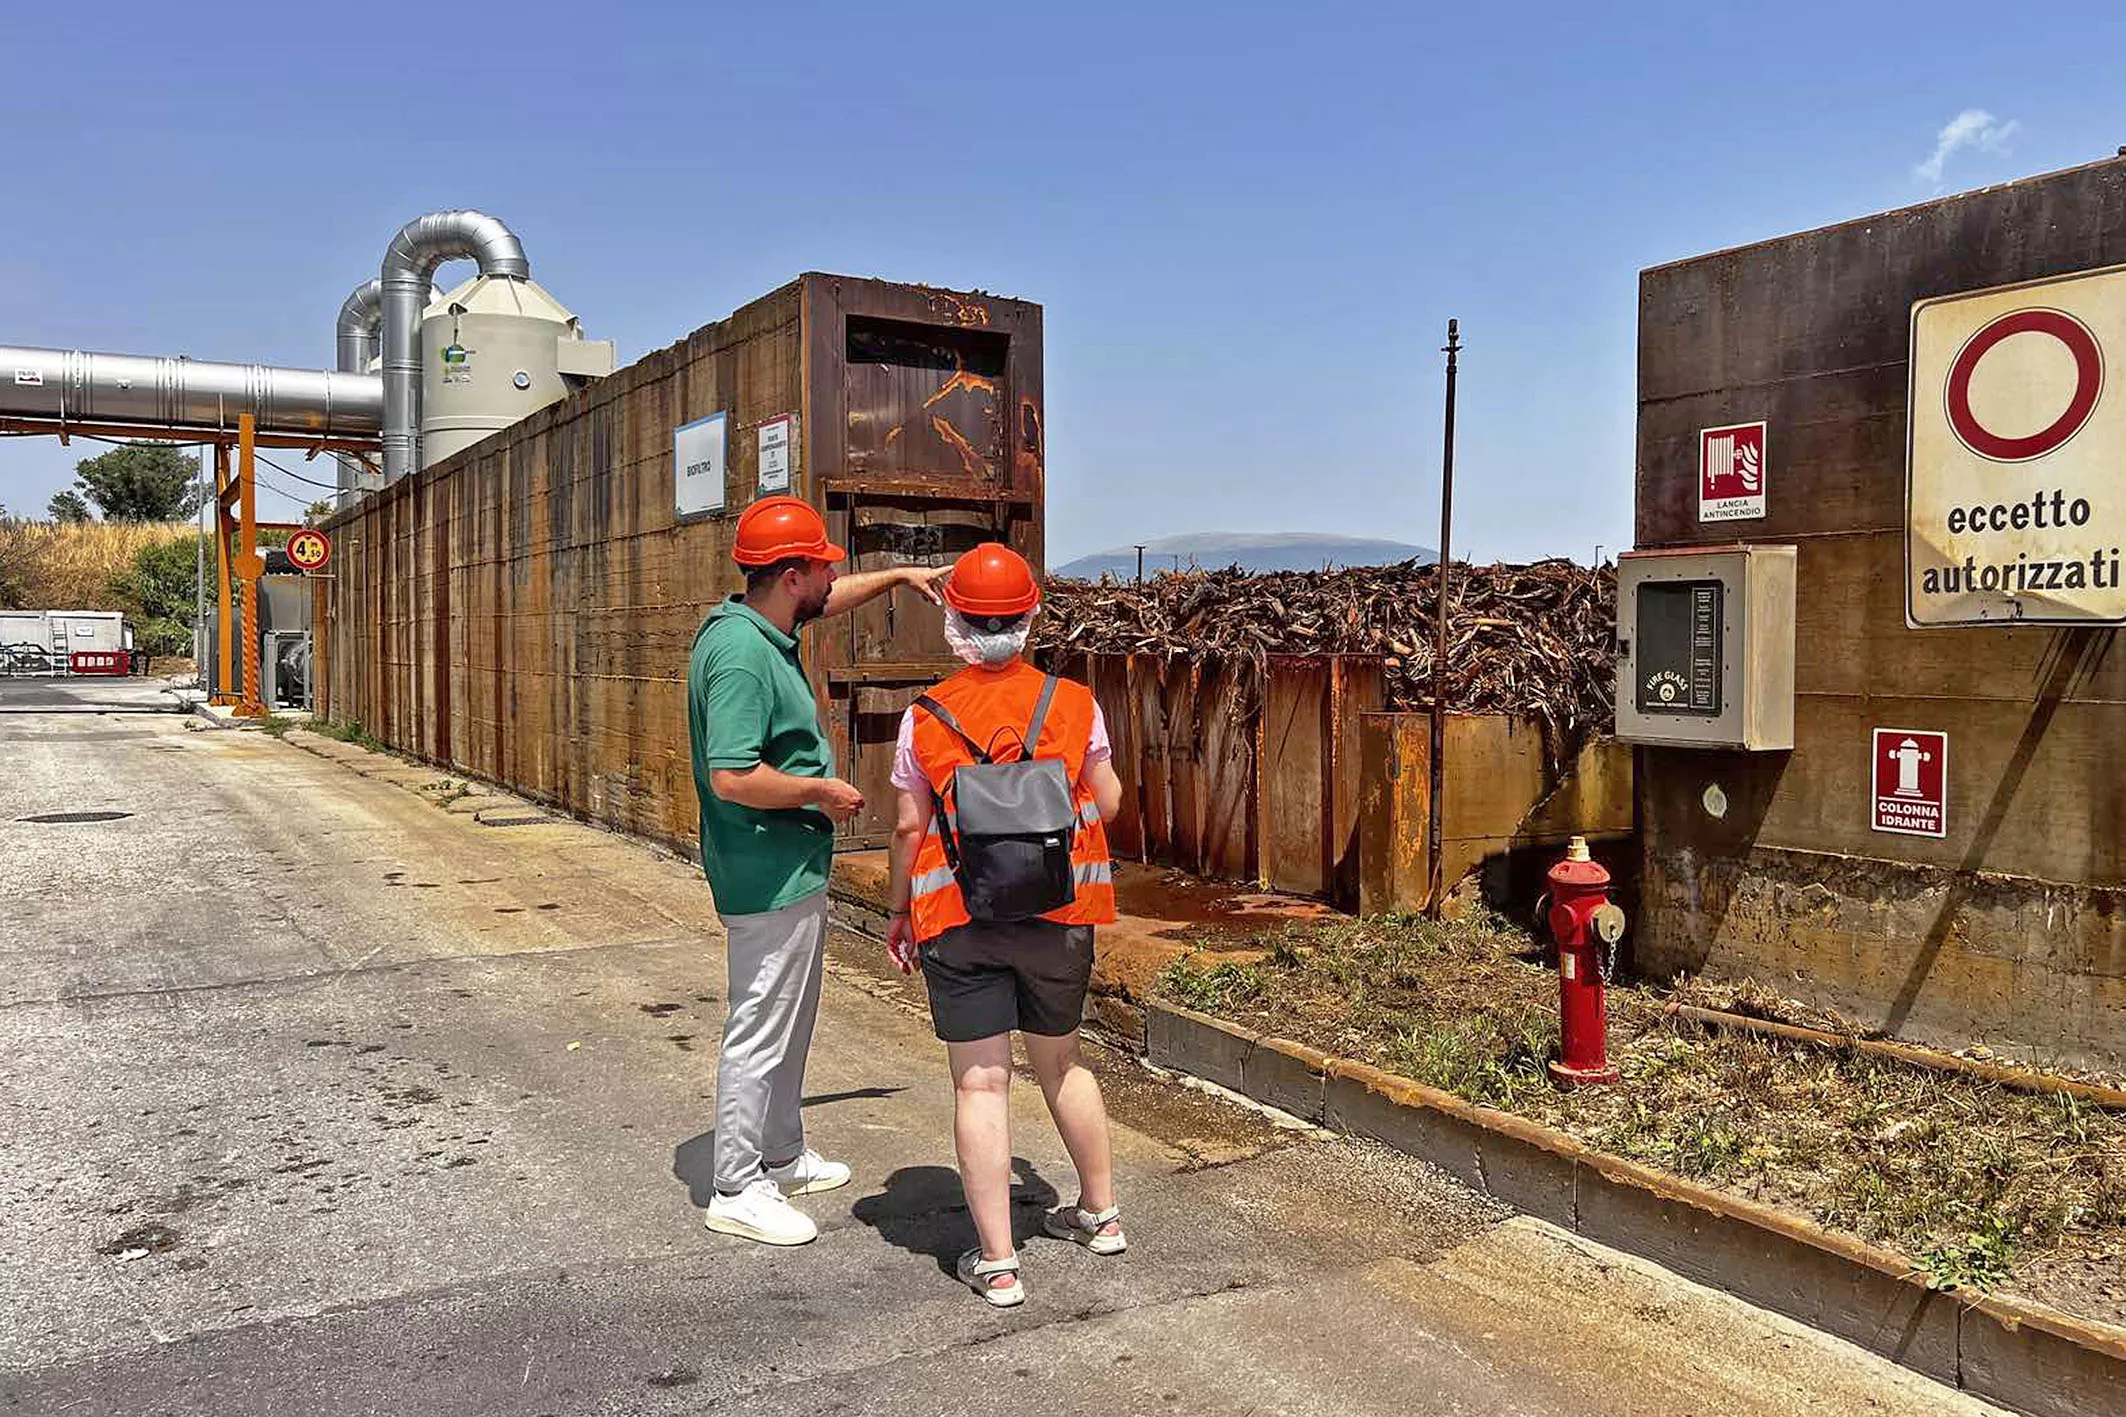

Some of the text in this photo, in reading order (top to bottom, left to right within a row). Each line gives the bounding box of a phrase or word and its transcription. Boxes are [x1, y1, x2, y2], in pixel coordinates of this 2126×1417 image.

[1717, 499, 1749, 509] LANCIA
[1947, 488, 2091, 534] eccetto
[1703, 507, 1761, 518] ANTINCENDIO
[296, 541, 306, 556] 4
[1922, 547, 2120, 594] autorizzati
[1646, 671, 1664, 691] FIRE
[1878, 801, 1939, 818] COLONNA
[1881, 815, 1936, 830] IDRANTE
